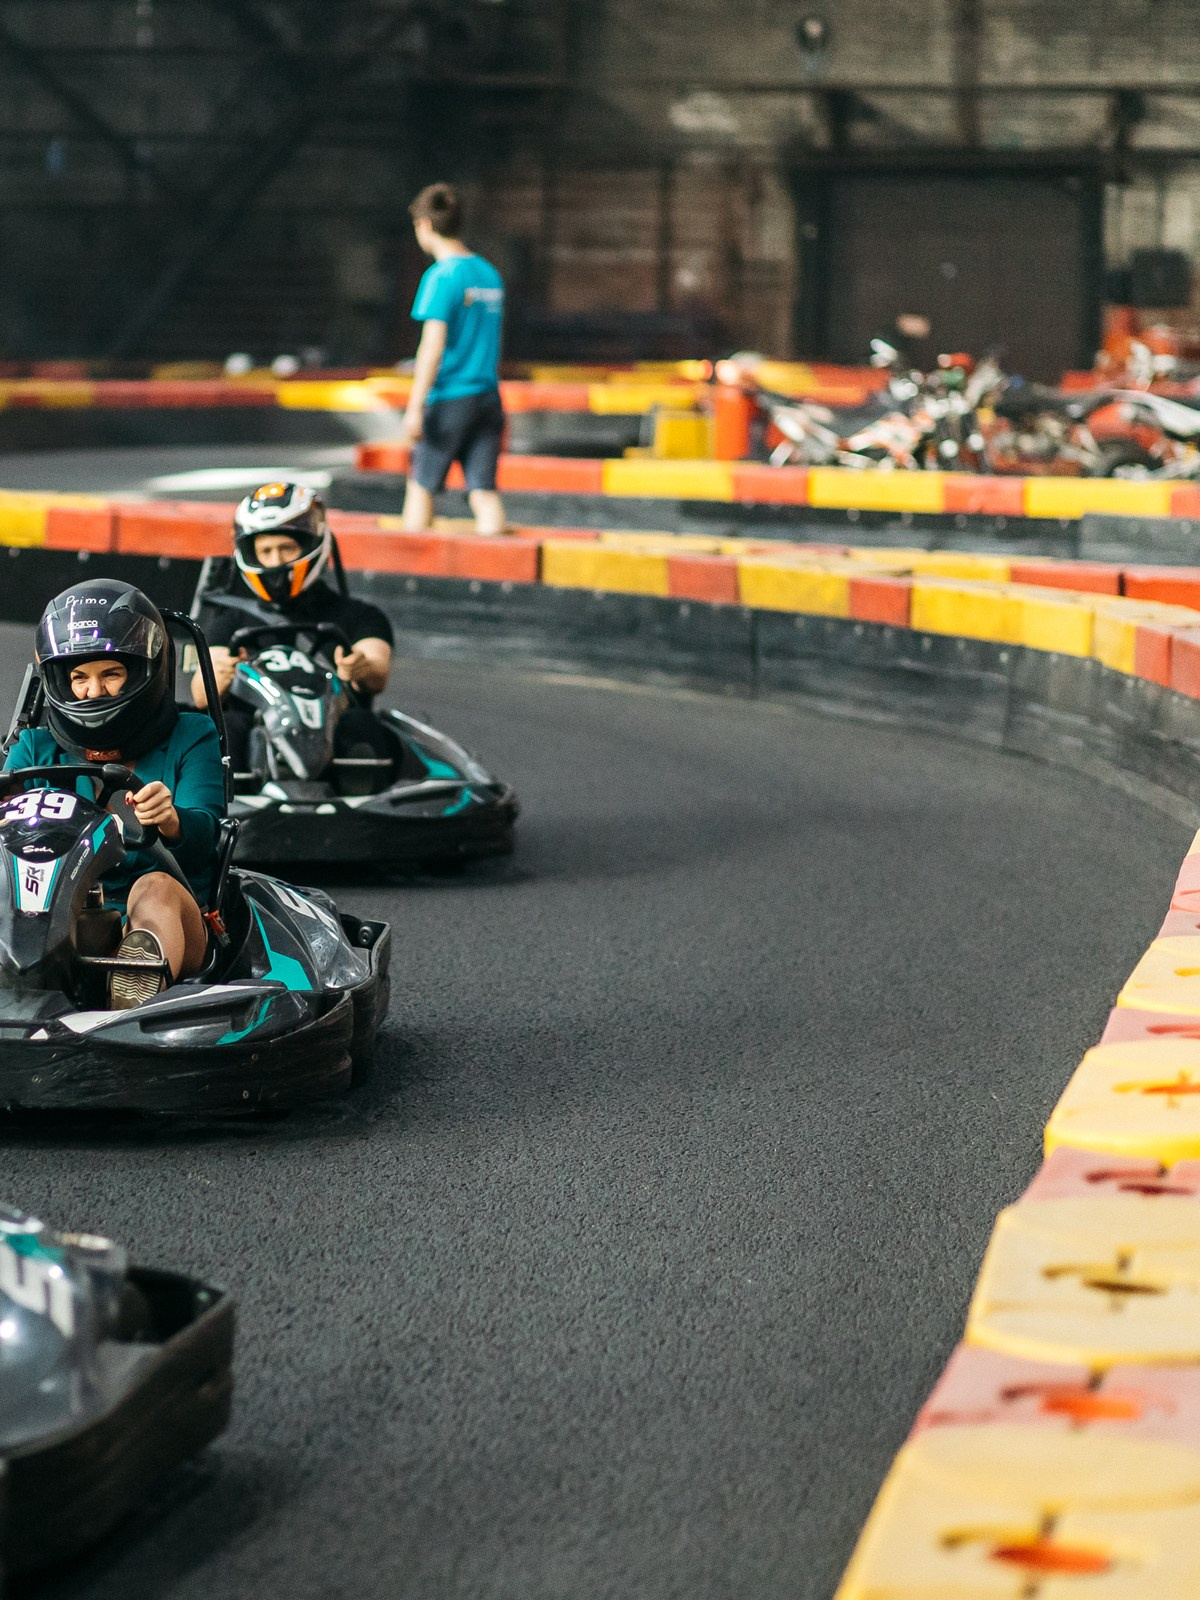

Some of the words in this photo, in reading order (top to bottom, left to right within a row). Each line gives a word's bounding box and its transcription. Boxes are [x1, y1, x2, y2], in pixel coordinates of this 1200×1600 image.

[65, 595, 107, 608] Primo
[259, 649, 315, 674] 34
[5, 792, 77, 820] 39
